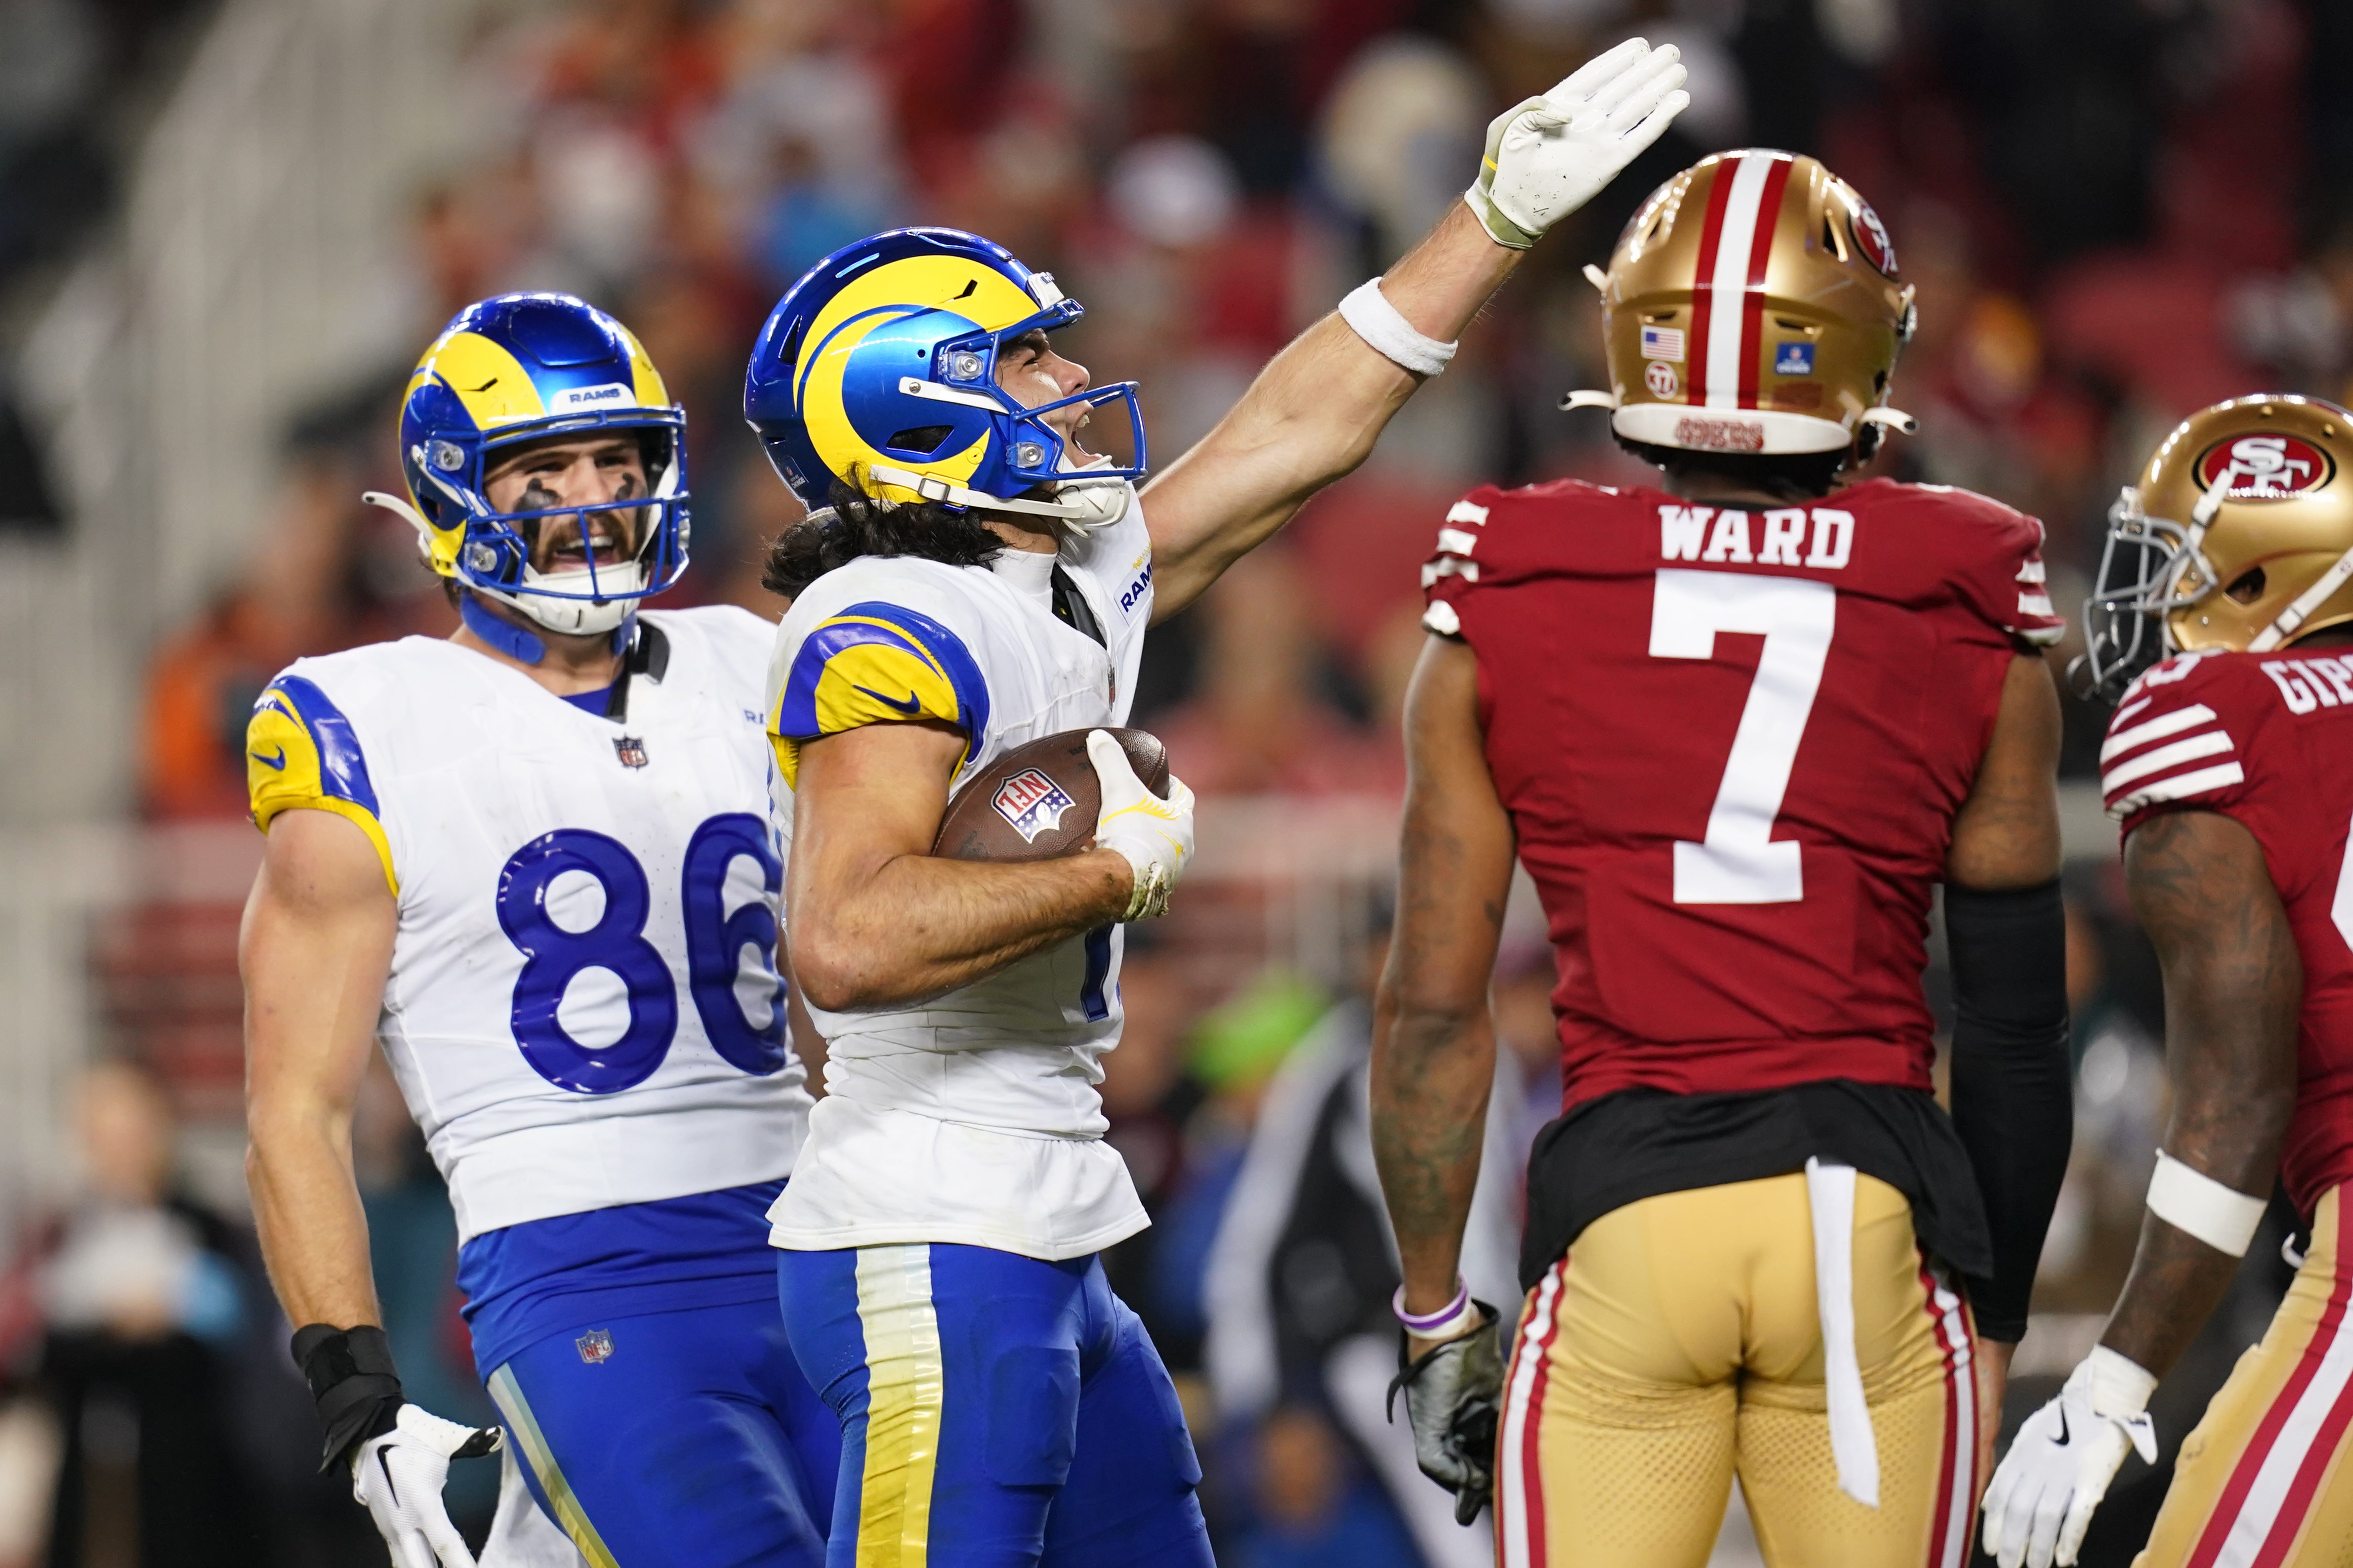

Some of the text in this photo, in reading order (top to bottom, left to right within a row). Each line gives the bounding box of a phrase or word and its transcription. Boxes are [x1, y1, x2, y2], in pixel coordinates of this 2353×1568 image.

[569, 388, 620, 403] RAMS
[1658, 505, 1855, 569] WARD
[1121, 563, 1152, 613] RAM
[1648, 568, 1837, 904] 7
[998, 773, 1050, 814] NFL
[496, 812, 787, 1095] 86
[585, 1339, 610, 1360] NFL
